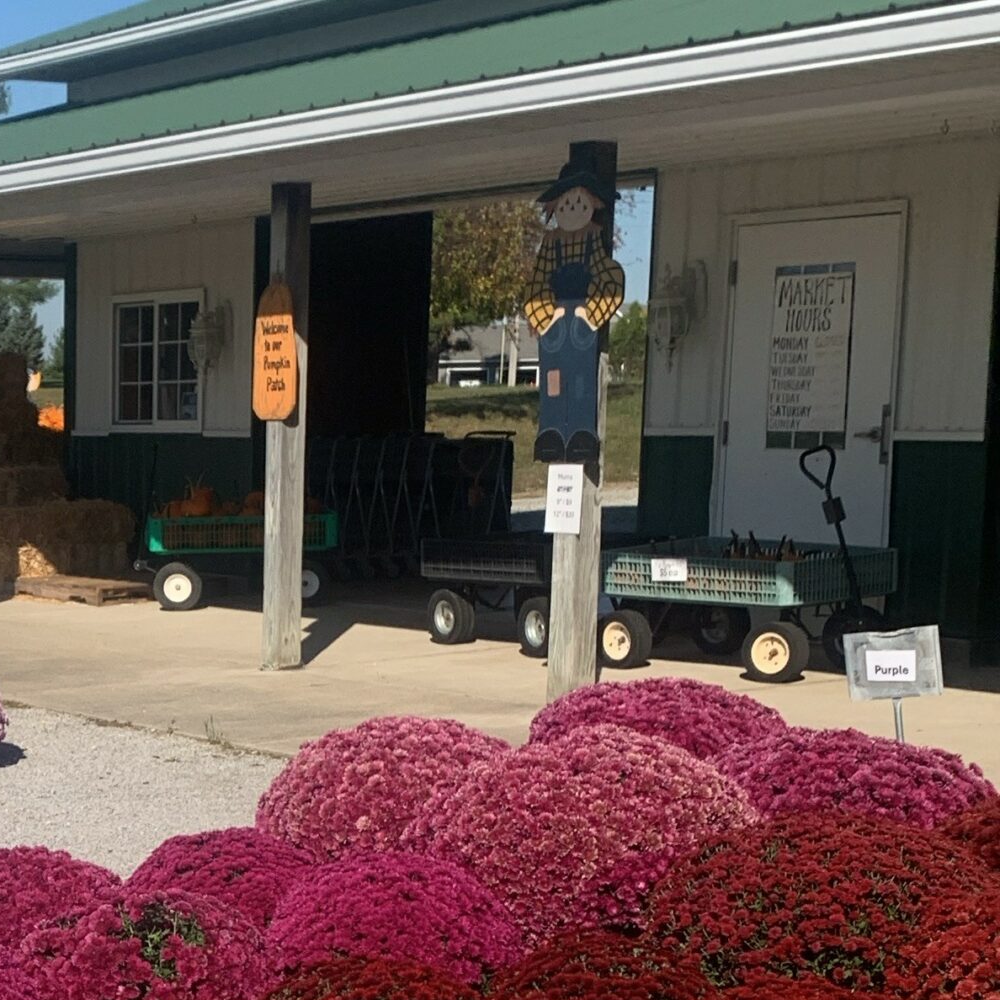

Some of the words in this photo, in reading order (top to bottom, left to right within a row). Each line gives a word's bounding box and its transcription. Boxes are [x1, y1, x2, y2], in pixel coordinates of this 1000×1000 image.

[779, 276, 852, 307] MARKET
[786, 307, 832, 333] HOURS
[261, 321, 289, 336] Welcome
[264, 340, 271, 352] to
[773, 337, 809, 350] MONDAY
[264, 356, 291, 375] Pumpkin
[266, 376, 286, 392] Patch
[769, 405, 812, 418] SATURDAY
[874, 664, 909, 677] Purple
